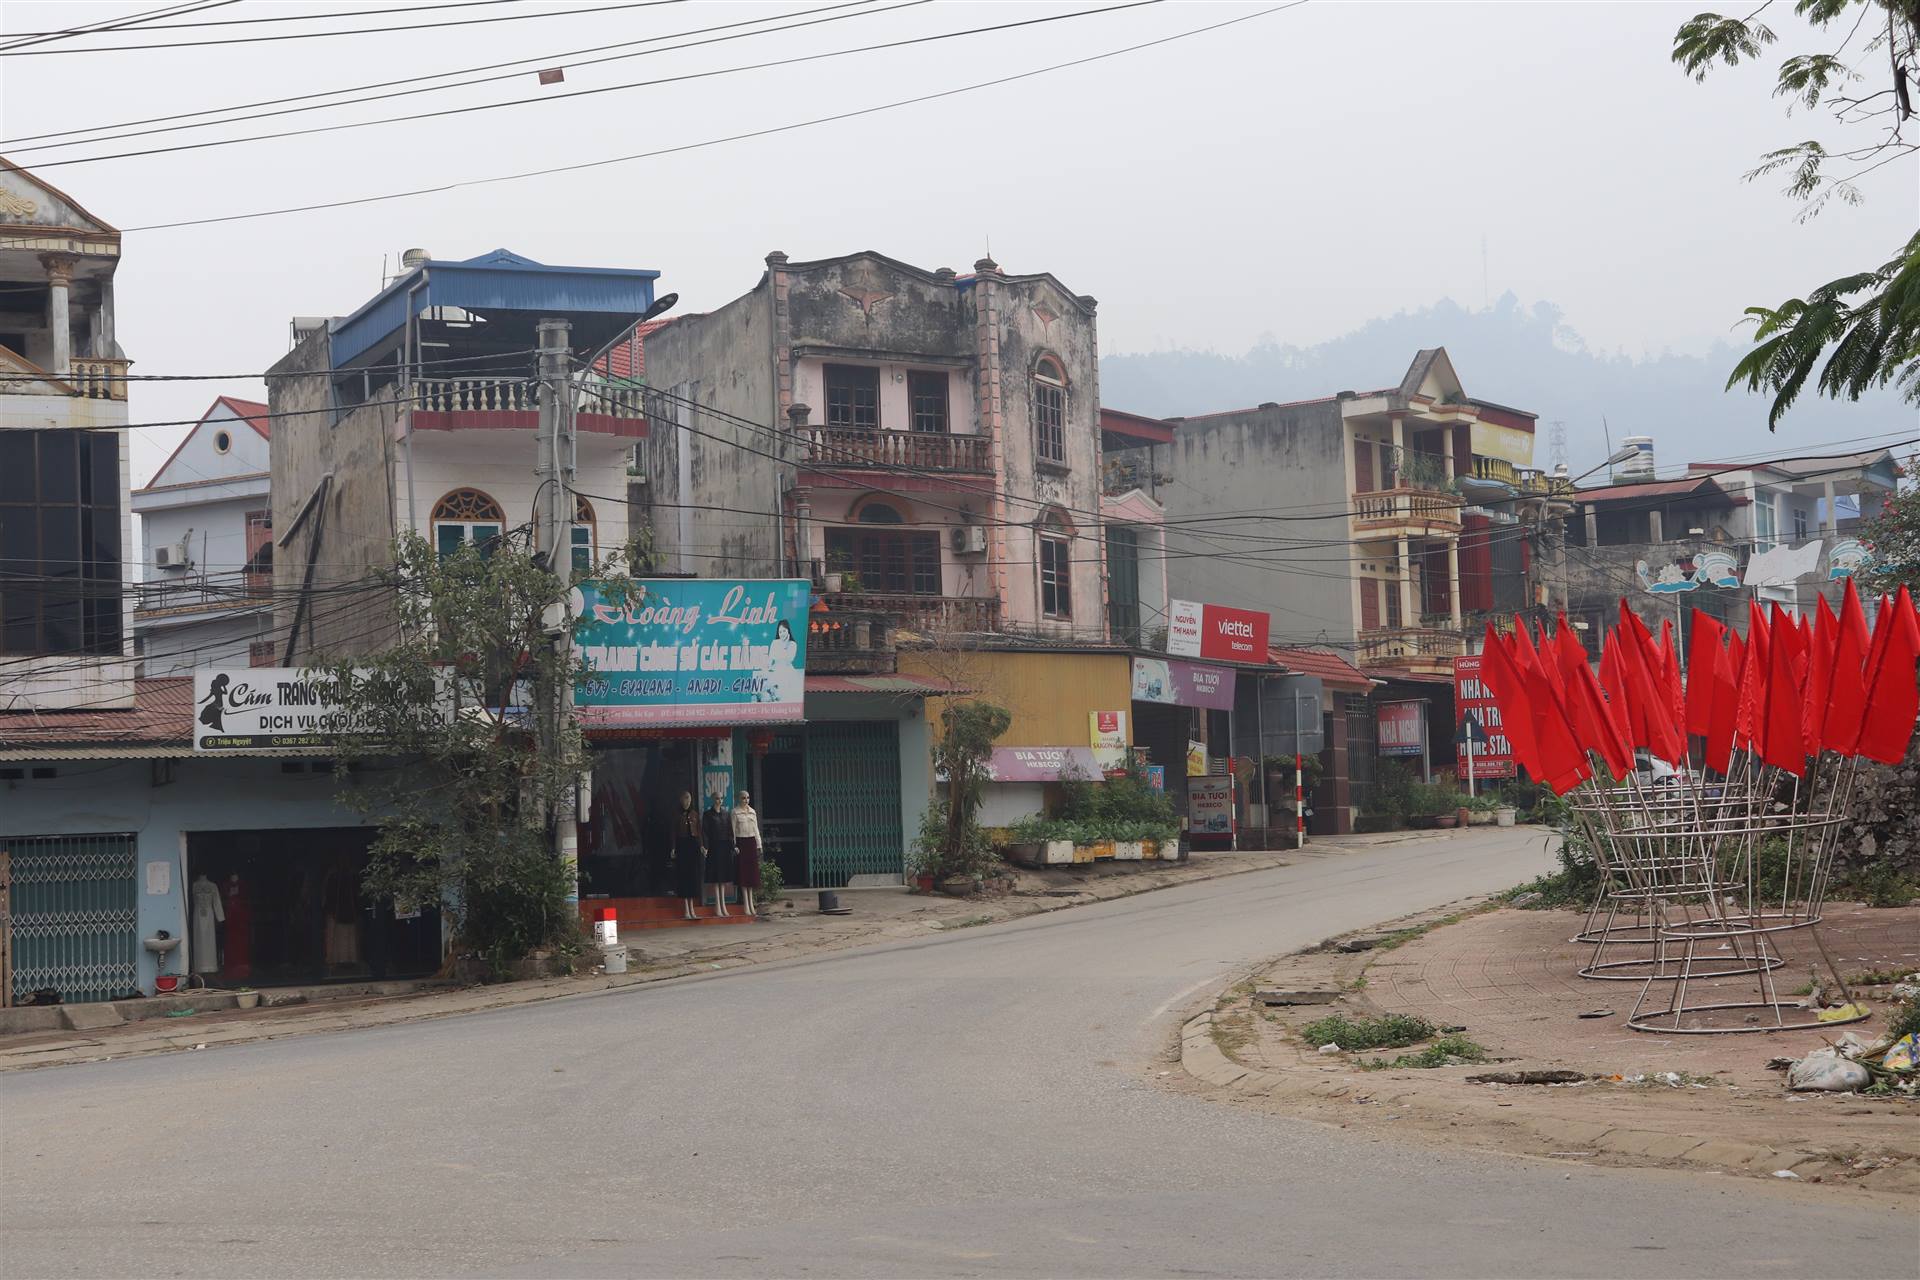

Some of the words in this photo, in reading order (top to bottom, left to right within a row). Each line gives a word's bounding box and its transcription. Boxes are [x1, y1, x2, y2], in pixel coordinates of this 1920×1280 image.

[706, 585, 778, 625] Linh
[1218, 619, 1253, 638] viettel
[1231, 641, 1253, 651] telecom
[620, 678, 673, 697] EVALANA
[687, 677, 722, 695] ANADI
[1193, 672, 1204, 684] BIA
[1460, 674, 1481, 699] NHÀ
[277, 682, 316, 706] TRANG
[259, 715, 292, 733] DỊCH
[1014, 751, 1035, 760] BIA
[705, 771, 730, 798] SHOP
